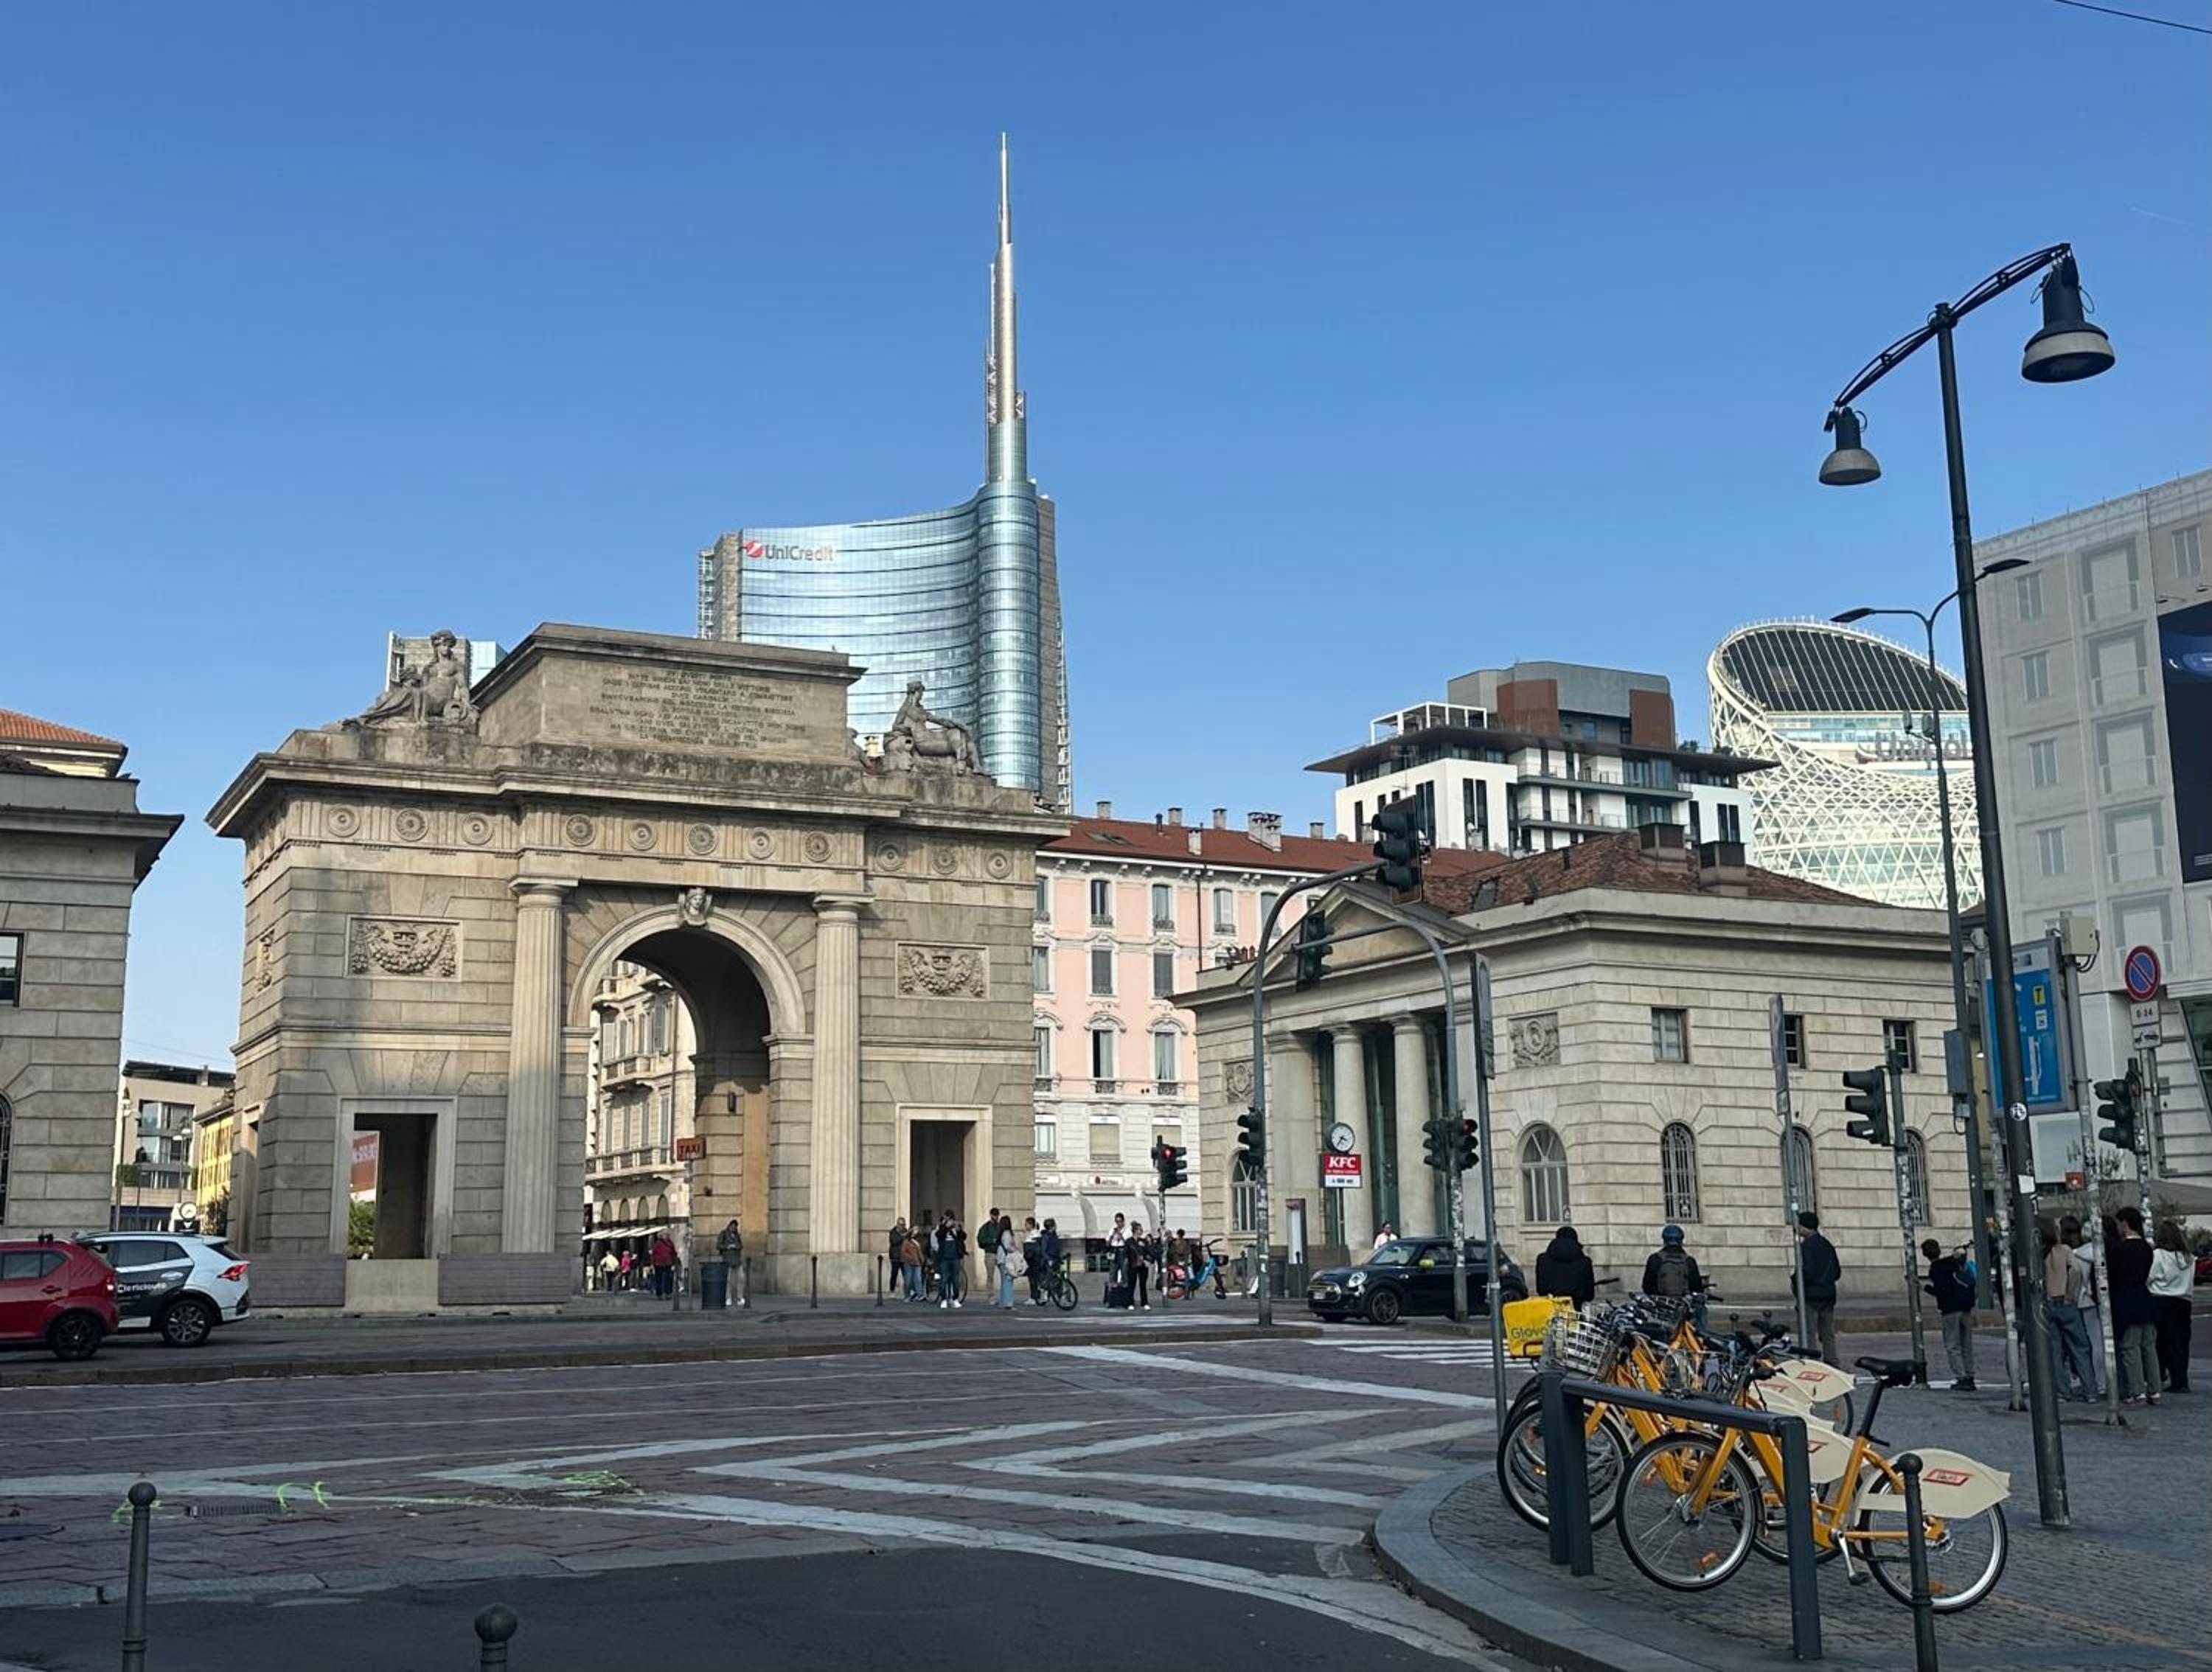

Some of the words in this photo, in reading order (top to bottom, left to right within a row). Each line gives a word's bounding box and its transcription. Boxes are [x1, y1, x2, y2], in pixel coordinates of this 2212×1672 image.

[765, 543, 834, 561] UniCredit
[680, 1145, 700, 1154] TAXI
[1328, 1156, 1356, 1168] KFC
